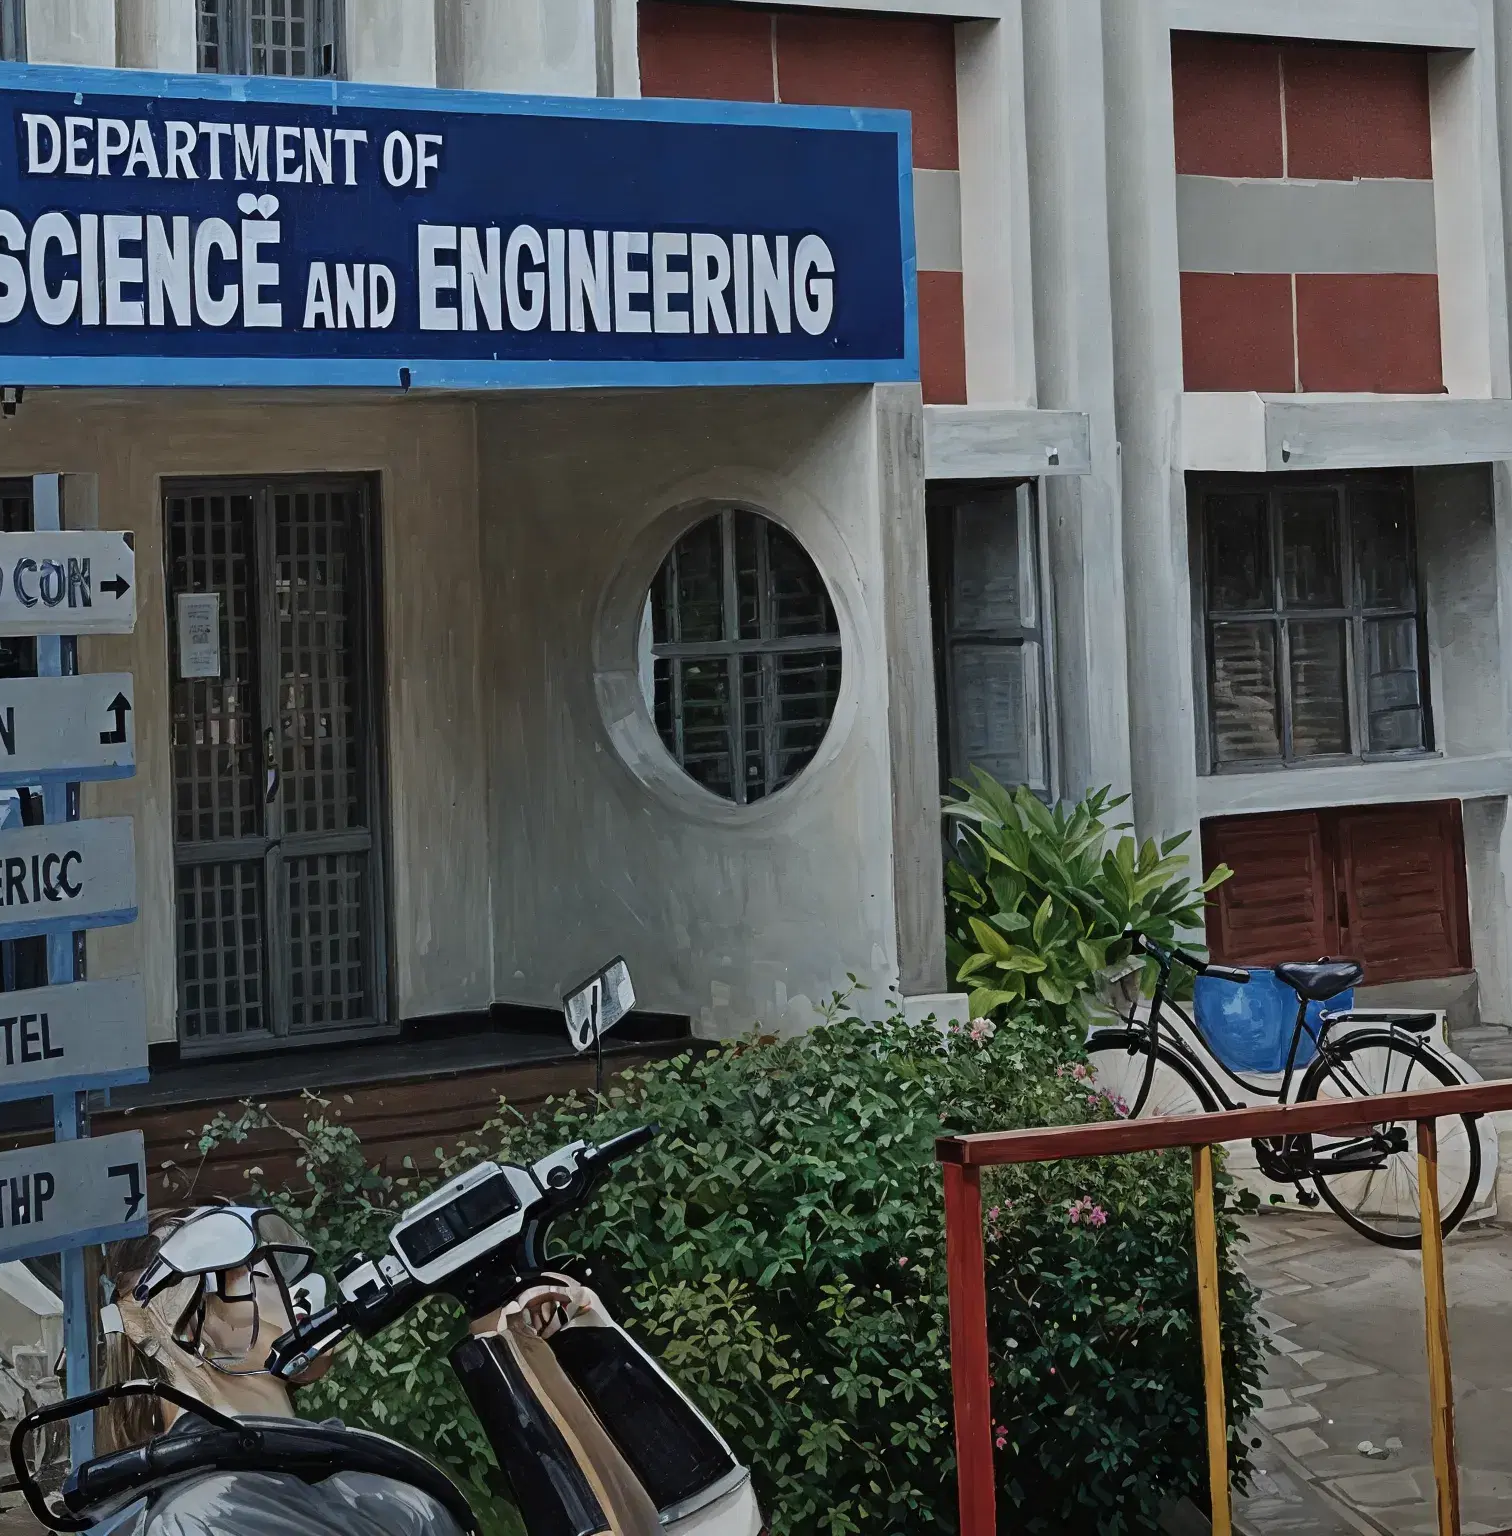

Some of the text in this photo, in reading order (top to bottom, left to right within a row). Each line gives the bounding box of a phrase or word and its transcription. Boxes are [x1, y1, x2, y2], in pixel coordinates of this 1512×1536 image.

[21, 112, 443, 189] DEPARTMENT OF
[302, 261, 396, 329] AND
[418, 222, 834, 335] ENGINEERING
